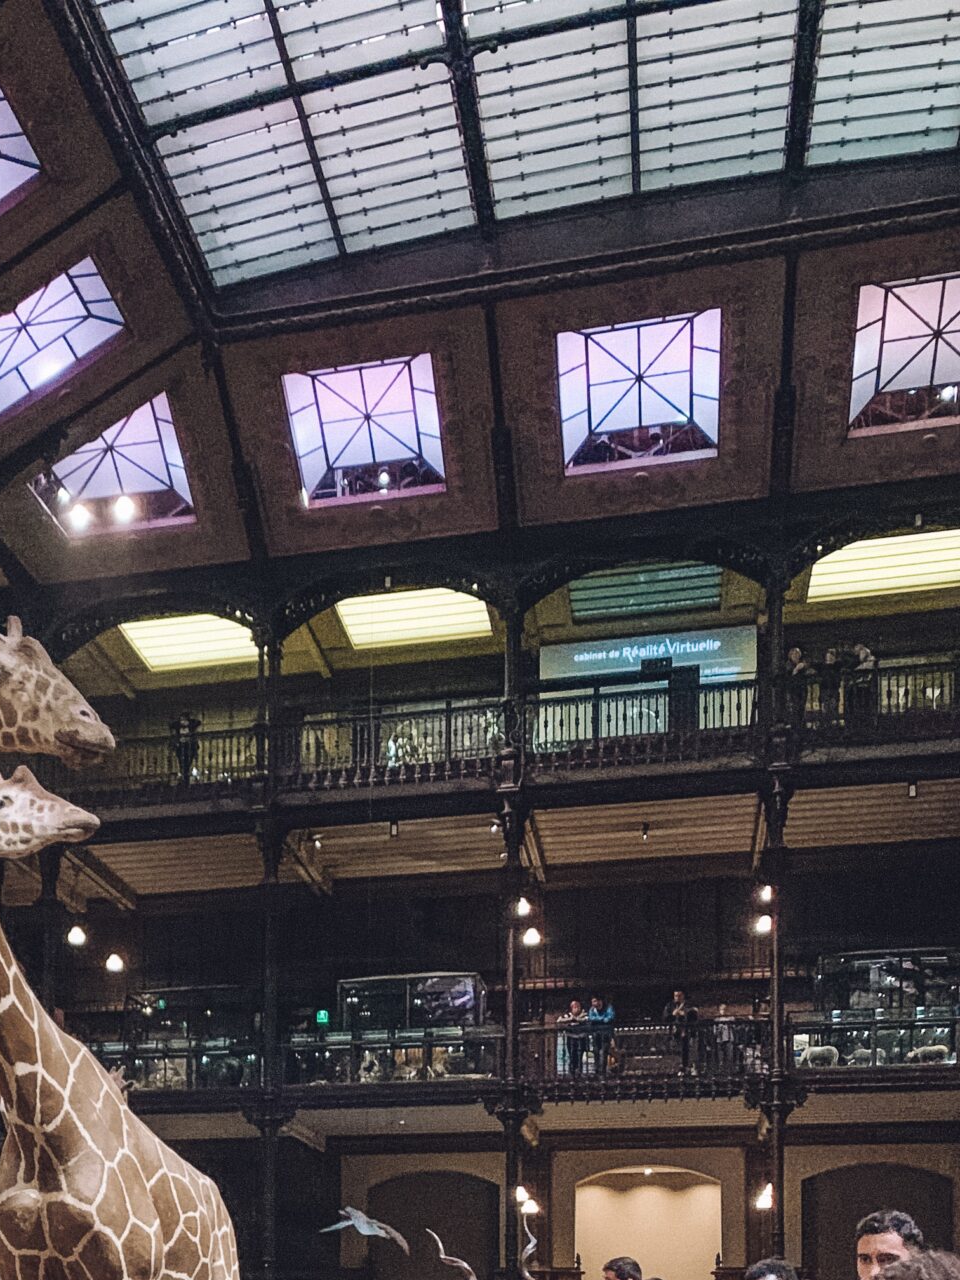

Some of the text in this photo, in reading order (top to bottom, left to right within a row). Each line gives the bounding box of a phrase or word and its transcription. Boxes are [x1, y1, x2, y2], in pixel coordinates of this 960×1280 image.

[574, 638, 721, 662] cabinet de Réalité Virtuelle
